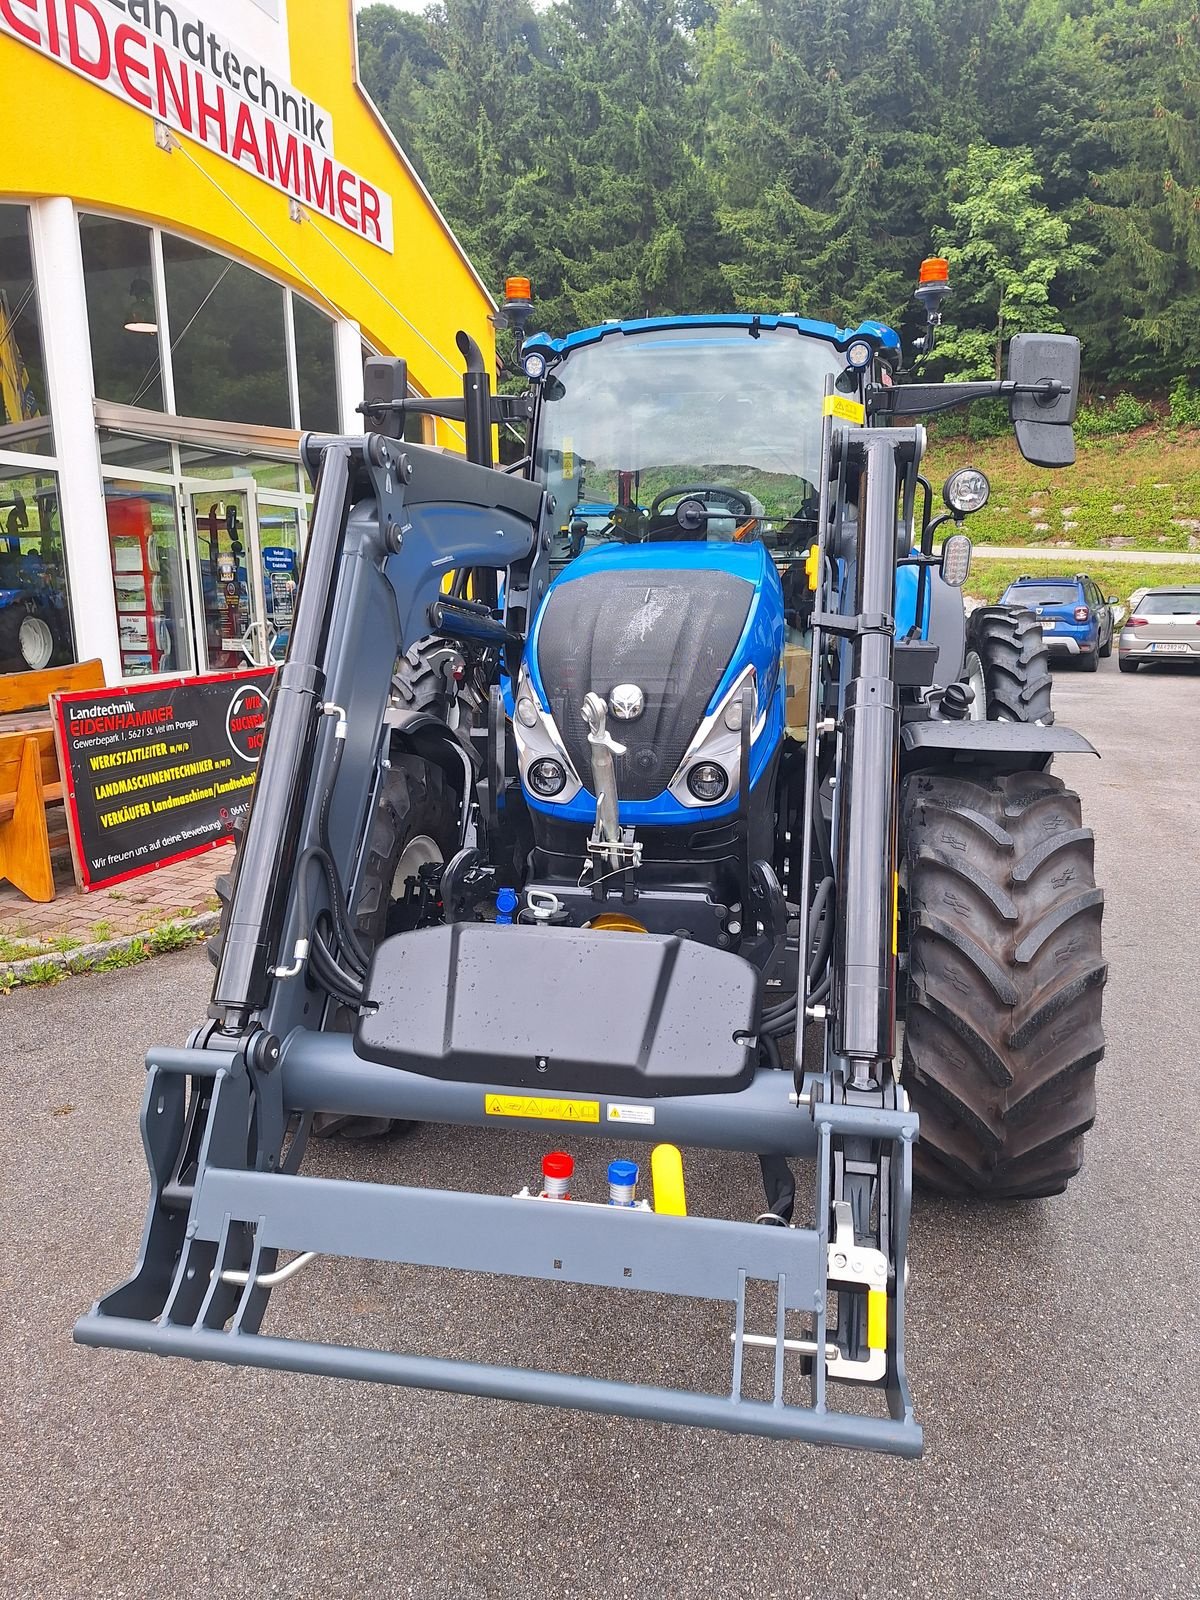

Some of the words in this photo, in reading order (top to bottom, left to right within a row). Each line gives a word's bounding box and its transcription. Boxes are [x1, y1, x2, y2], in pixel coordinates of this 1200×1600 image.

[108, 0, 326, 149] andtechnik
[70, 701, 136, 720] Landtechnik
[244, 696, 263, 710] WIR
[70, 705, 174, 737] EIDENHAMMER
[73, 733, 119, 749] Gewerbepark
[128, 728, 145, 740] 5621
[155, 724, 166, 734] Veit
[166, 722, 175, 731] im
[175, 720, 198, 730] Pongau
[230, 714, 264, 733] SUCHEN
[90, 743, 168, 771] WERKSTATTLEITER
[95, 759, 213, 800] LANDMASCHINENTECHNIKER
[100, 801, 151, 828] VERKÄUFER
[92, 858, 107, 869] Wir
[108, 850, 134, 865] freuen
[135, 845, 149, 856] uns
[149, 839, 161, 851] auf
[162, 834, 182, 847] deine
[181, 820, 222, 839] Bewerbung!
